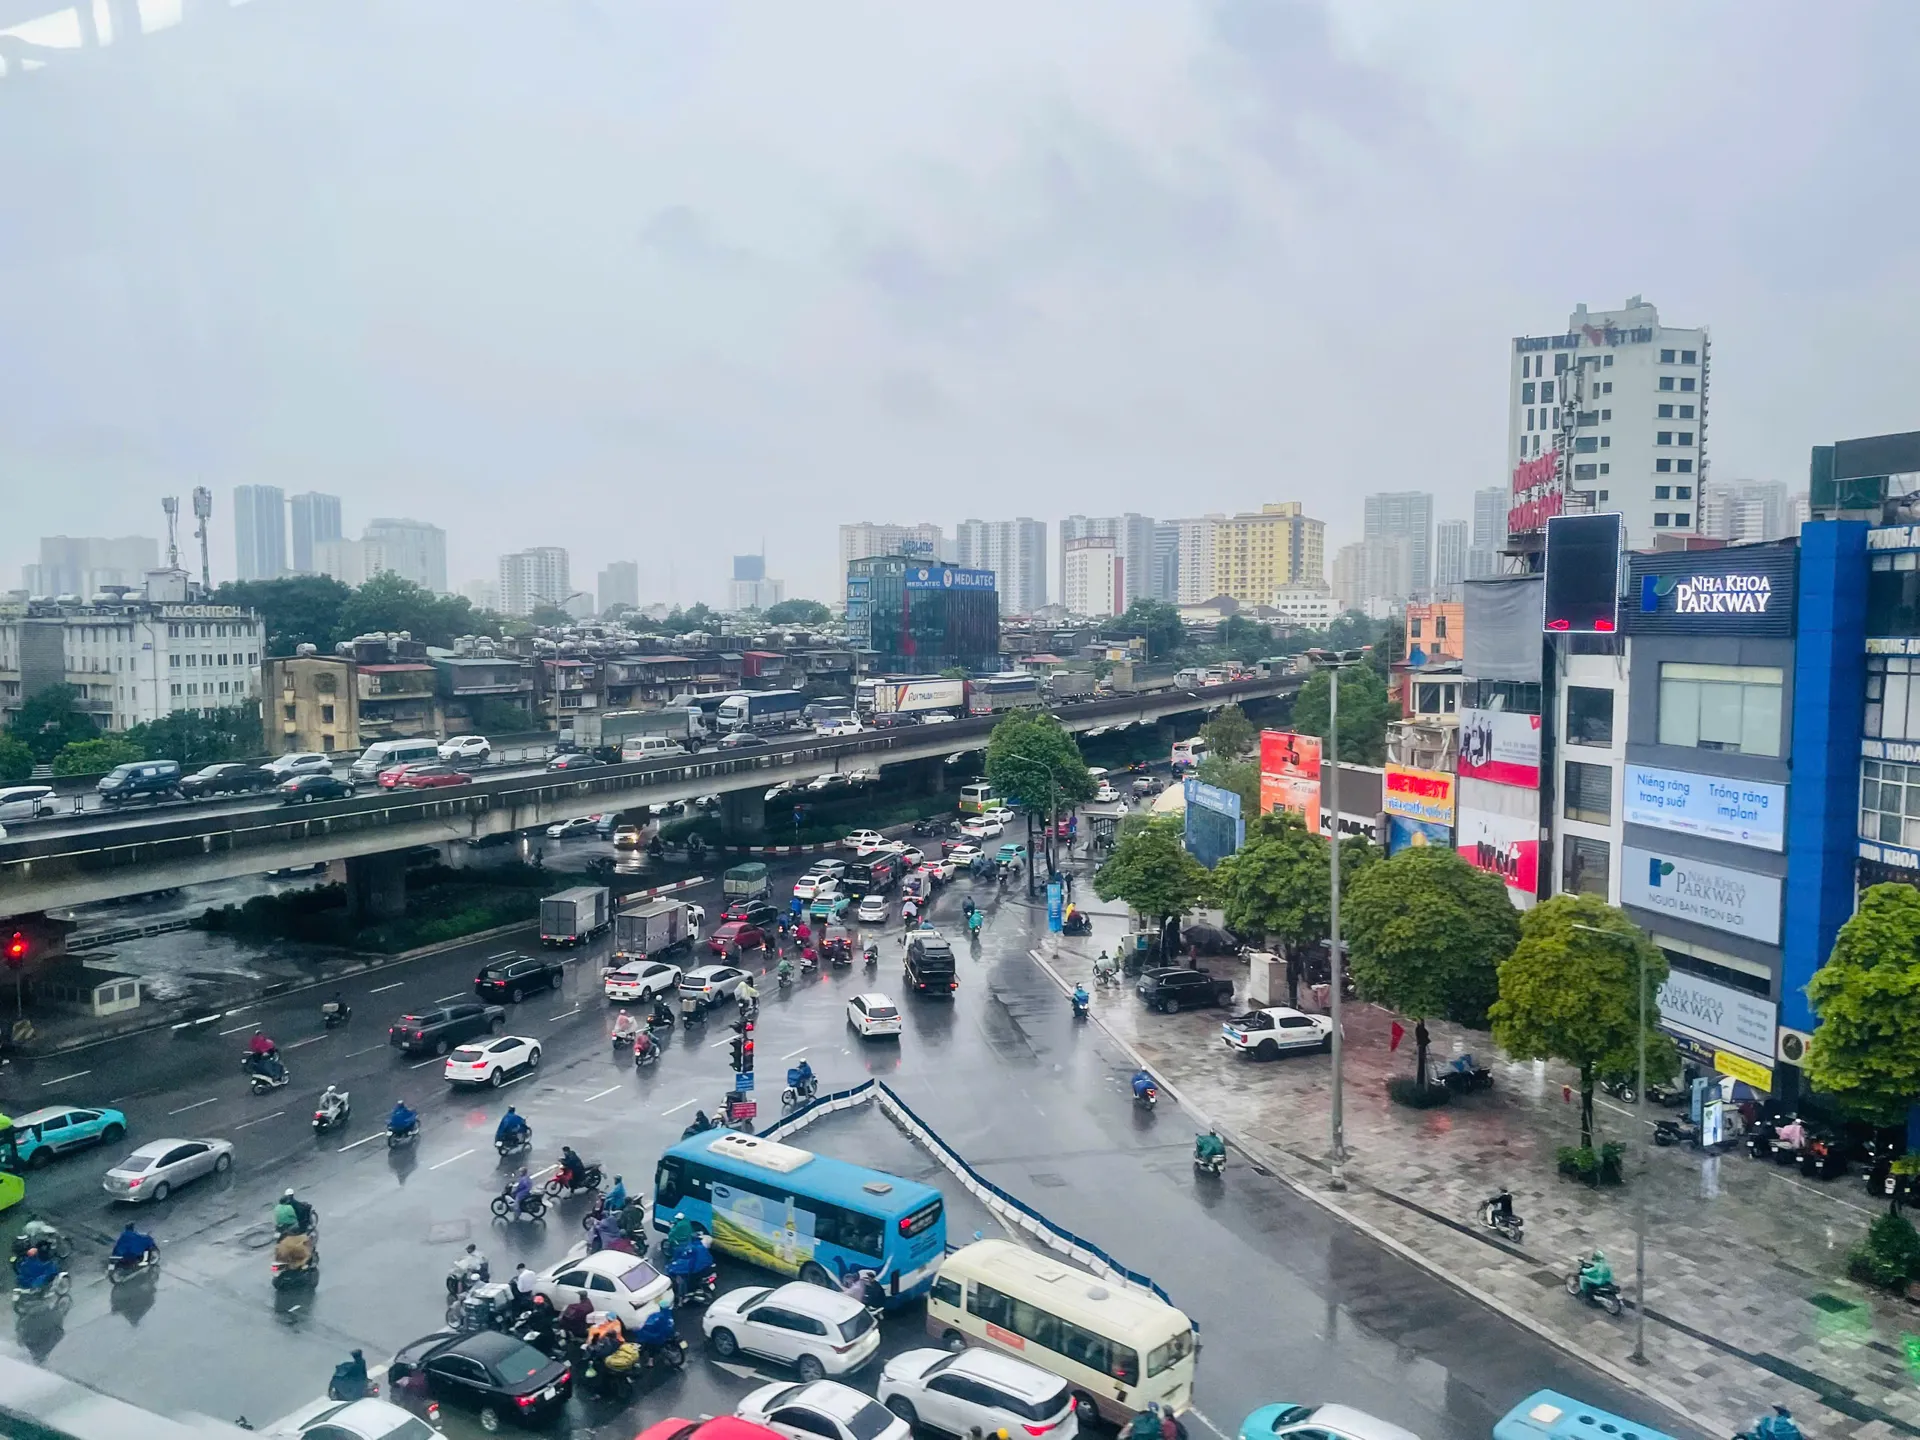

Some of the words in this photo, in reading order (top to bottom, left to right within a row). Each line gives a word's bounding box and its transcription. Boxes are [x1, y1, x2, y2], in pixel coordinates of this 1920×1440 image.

[954, 573, 994, 587] MEDLATEC
[1691, 575, 1724, 592] NHA
[1725, 574, 1771, 592] KHOA
[1675, 584, 1772, 613] PARKWAY
[162, 605, 241, 618] NACENTECH
[1667, 779, 1690, 796] răng
[1709, 783, 1739, 804] Trồng
[1742, 791, 1769, 808] răng
[1639, 791, 1664, 808] trong
[1666, 794, 1686, 809] suốt
[1717, 803, 1758, 820] implant
[1883, 848, 1919, 870] KHOA
[1676, 872, 1747, 909] PARKWAY
[1688, 870, 1713, 886] NHA
[1714, 874, 1746, 893] KHOA
[1666, 983, 1689, 1000] NHA
[1692, 990, 1724, 1013] KHOA
